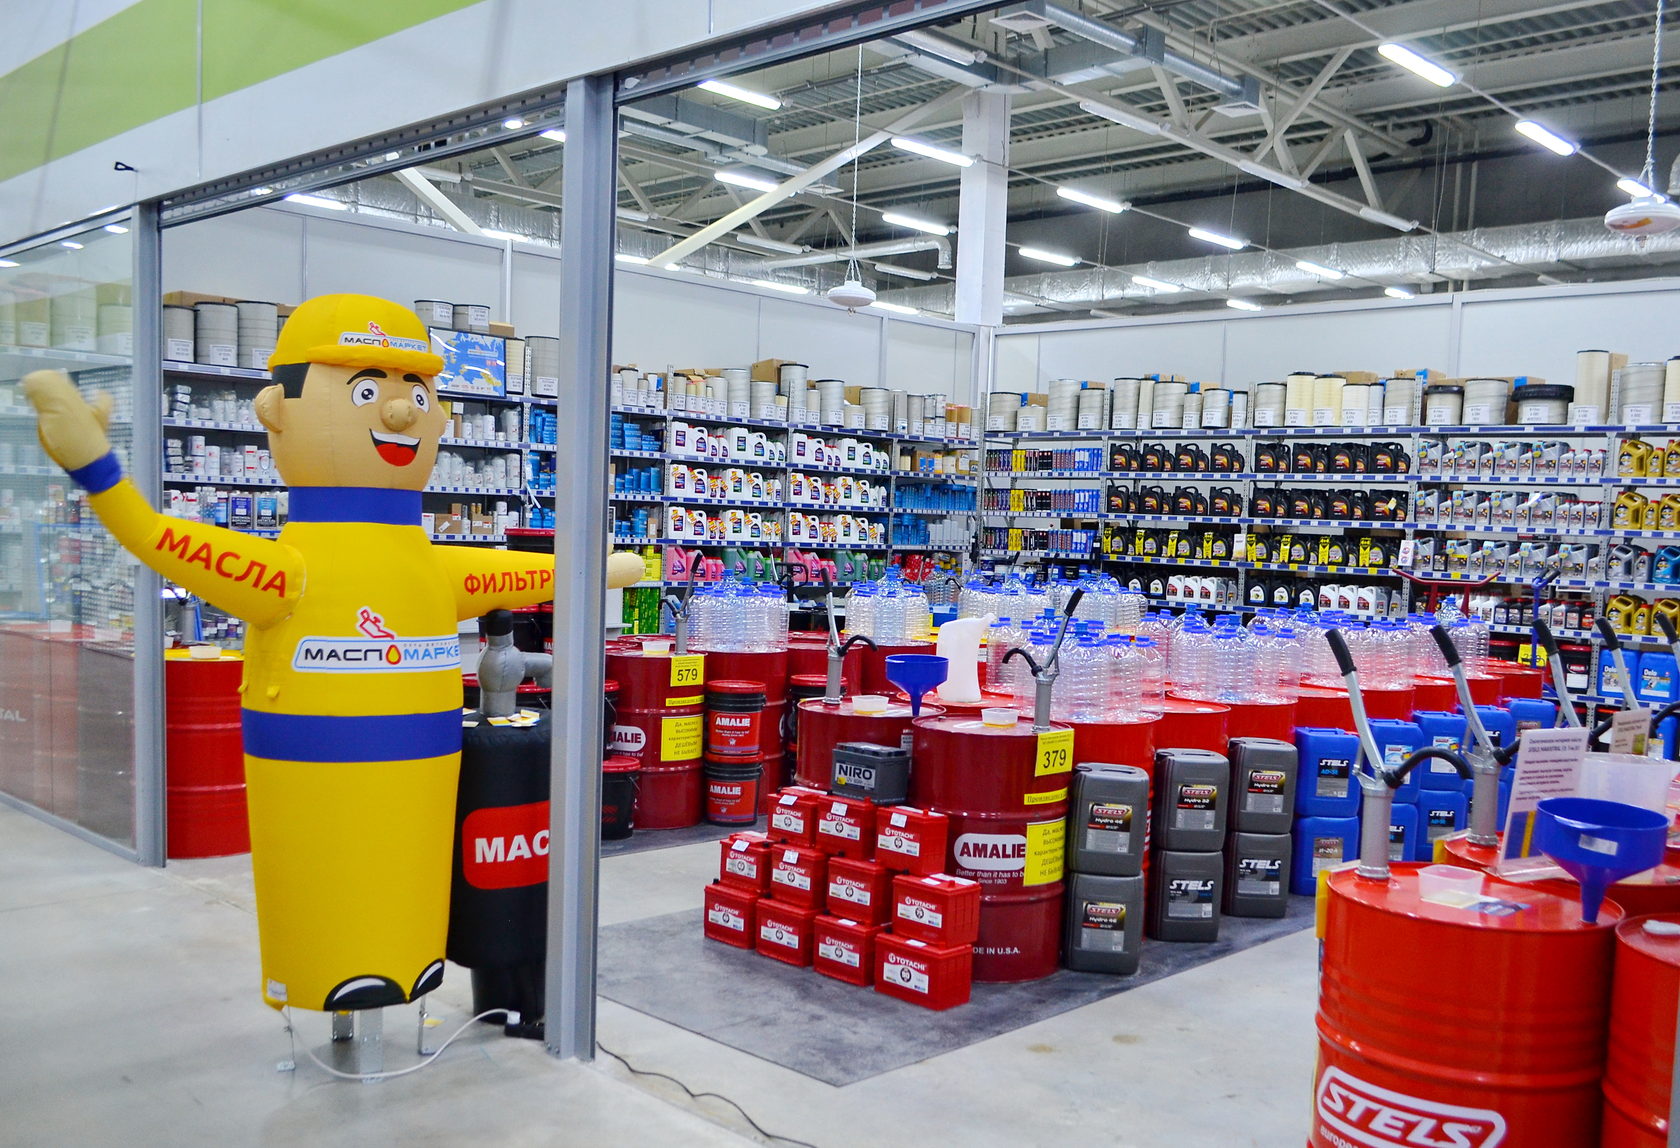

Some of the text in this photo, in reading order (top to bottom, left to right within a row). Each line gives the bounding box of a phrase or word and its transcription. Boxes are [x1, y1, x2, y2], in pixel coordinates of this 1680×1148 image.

[155, 527, 287, 599] МАСЛА
[464, 568, 555, 596] ФИЛЬТР
[677, 668, 698, 682] 579
[715, 716, 751, 727] AMALIE
[614, 732, 642, 743] ALIE
[1043, 749, 1067, 769] 379
[838, 764, 873, 780] NIRO
[710, 785, 741, 795] AMALIE
[781, 808, 803, 817] TOTACHI
[832, 814, 855, 824] TOTACHI
[890, 829, 915, 839] TOTACHI
[475, 829, 550, 864] МАС
[959, 842, 1026, 859] AMALIE
[735, 853, 755, 863] TOTACHI
[784, 864, 806, 875] TOTACHI
[1239, 859, 1282, 870] STELS
[956, 868, 976, 877] Better
[977, 870, 992, 878] than
[1012, 870, 1019, 878] to
[842, 878, 866, 889] TOTACHI
[1169, 880, 1214, 891] STELS
[911, 898, 937, 911] TOTACHI
[720, 905, 739, 916] TOTACHI
[772, 922, 794, 933] TOTACHI
[831, 939, 854, 950] TOTACHI
[997, 947, 1021, 955] U.S.A.
[895, 956, 926, 972] TOTACHI
[1323, 1081, 1483, 1148] STELS
[1321, 1124, 1359, 1148] europe
